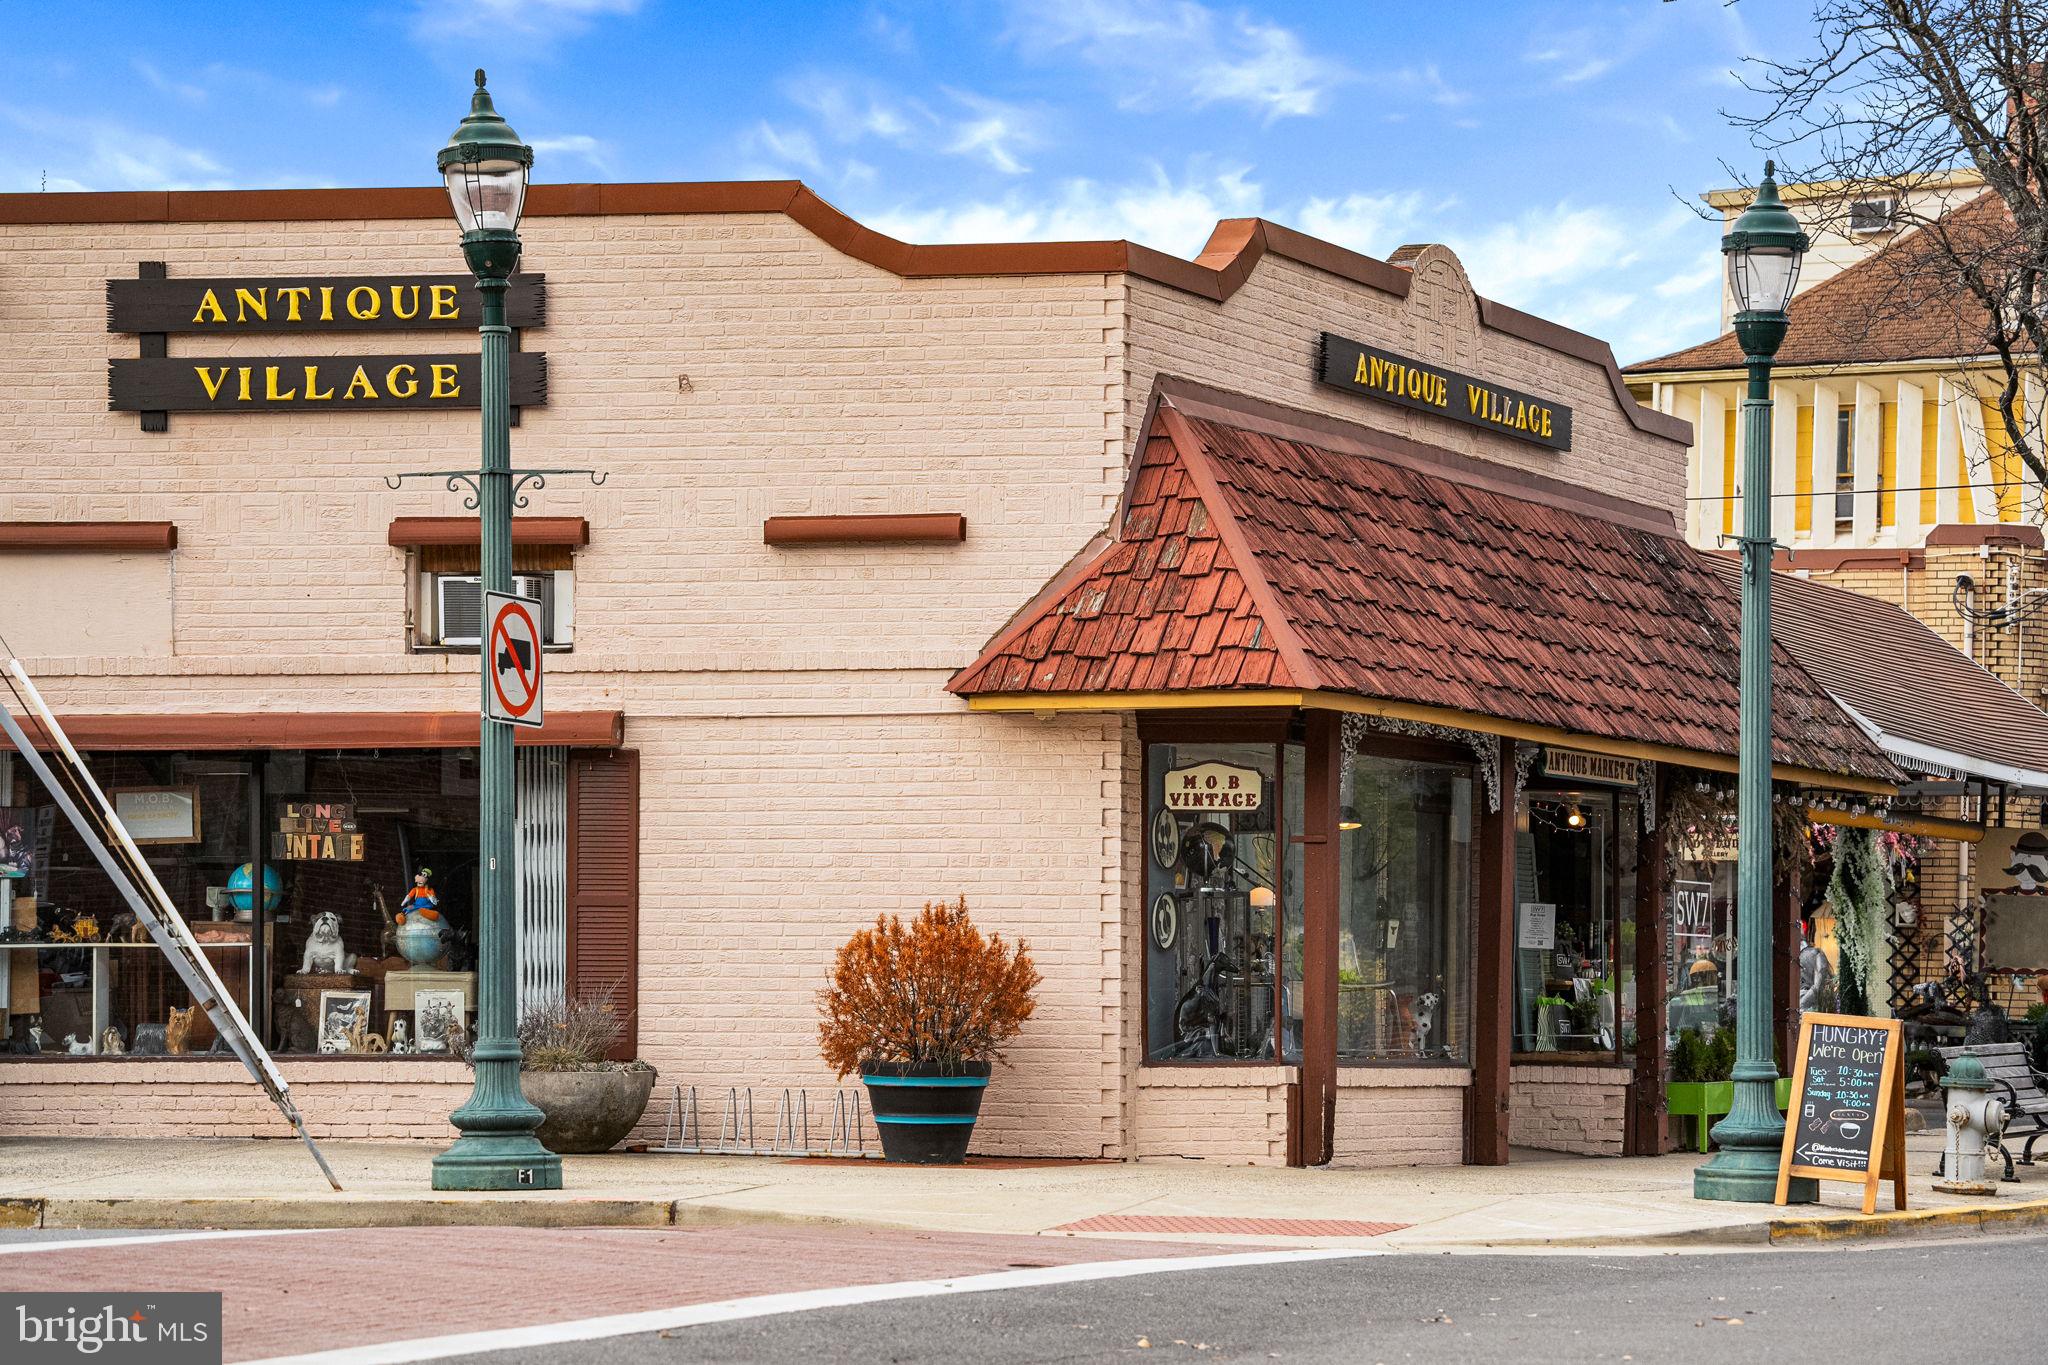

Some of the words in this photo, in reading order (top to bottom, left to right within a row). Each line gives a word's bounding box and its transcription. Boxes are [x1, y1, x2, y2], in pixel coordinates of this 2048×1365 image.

[192, 285, 460, 323] ANTIQUE
[194, 364, 461, 401] VILLAGE
[1354, 352, 1448, 408] ANTIQUE
[1466, 383, 1553, 438] VILLAGE
[1548, 751, 1588, 776] ANTIQUE
[1589, 757, 1625, 780] MARKET
[1169, 792, 1257, 807] VINTAGE
[287, 804, 346, 818] LONG
[1676, 890, 1710, 927] SW7
[1813, 1025, 1888, 1046] HUNGRY?
[1813, 1043, 1847, 1060] We're
[1812, 1075, 1825, 1083] Sat
[1812, 1155, 1835, 1166] Come
[518, 1168, 533, 1184] F1
